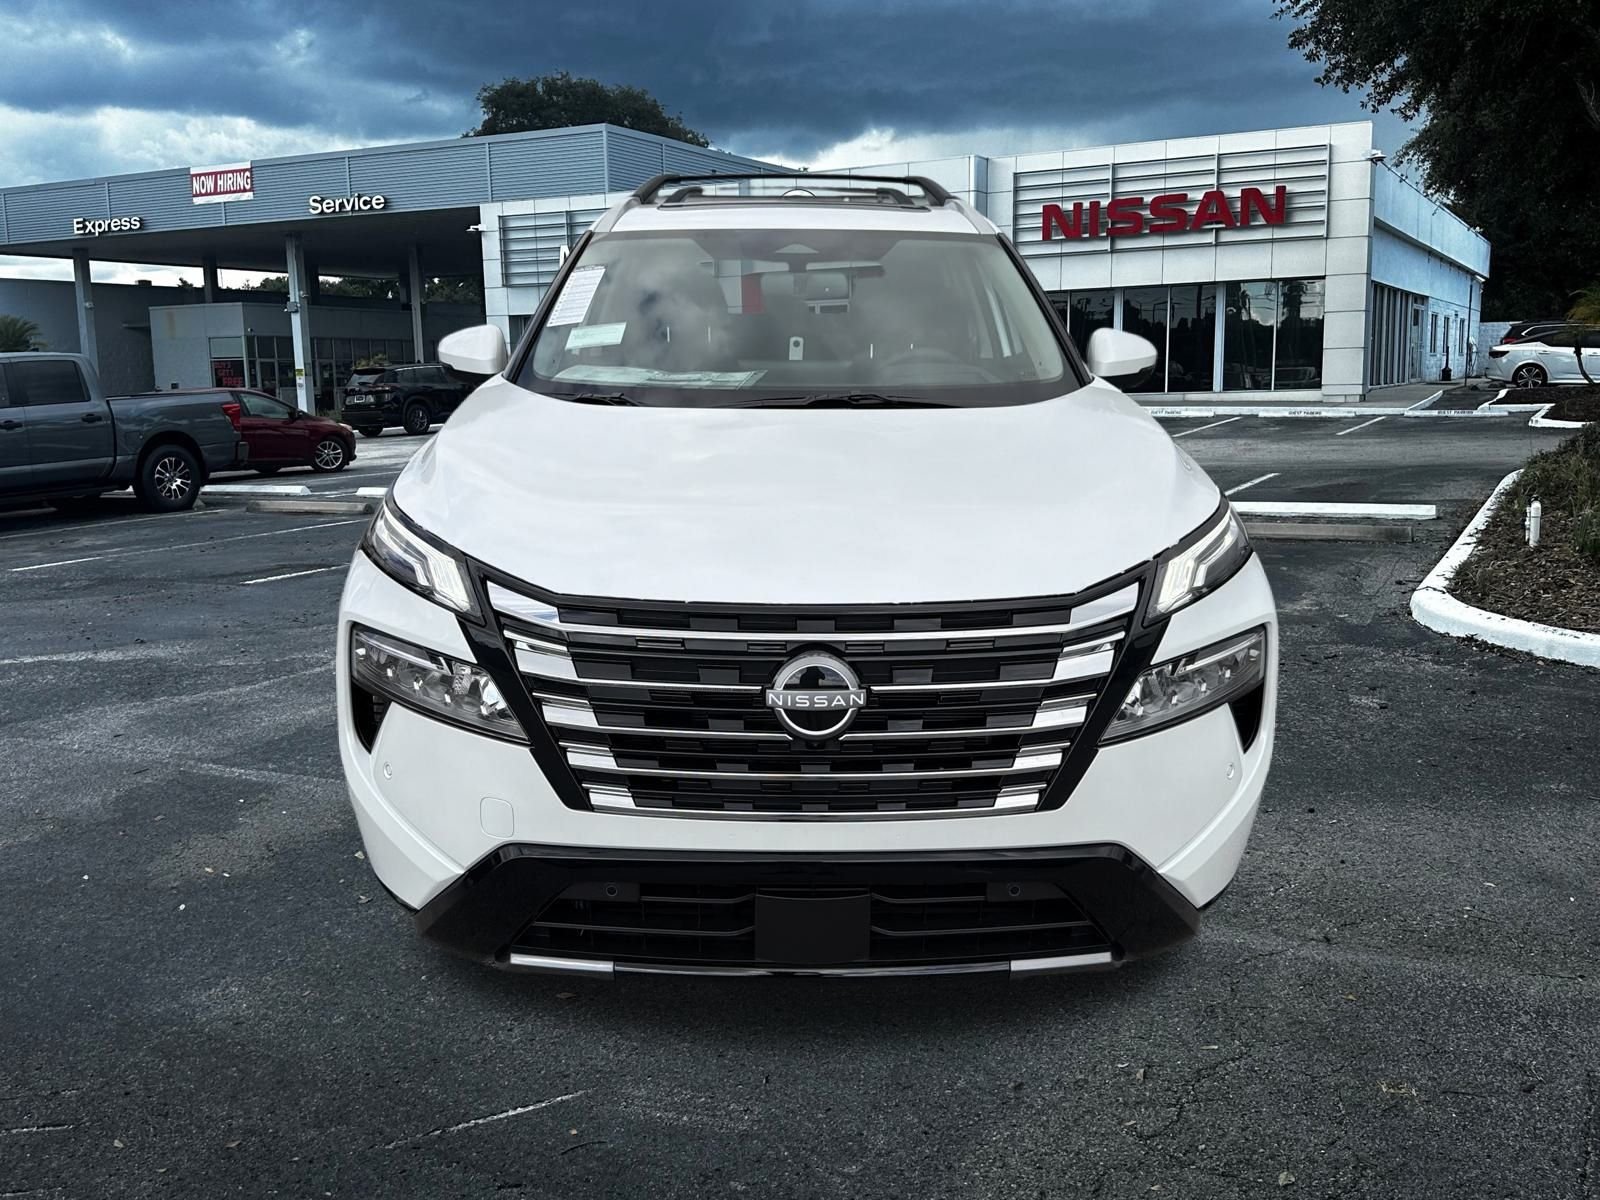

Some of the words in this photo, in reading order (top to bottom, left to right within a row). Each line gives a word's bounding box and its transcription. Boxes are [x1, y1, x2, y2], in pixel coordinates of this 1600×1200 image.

[192, 174, 215, 195] NOW
[217, 171, 251, 192] HIRING
[308, 192, 385, 214] Service
[1042, 185, 1287, 241] NISSAN
[73, 216, 141, 237] Express
[768, 692, 864, 708] NISSAN
